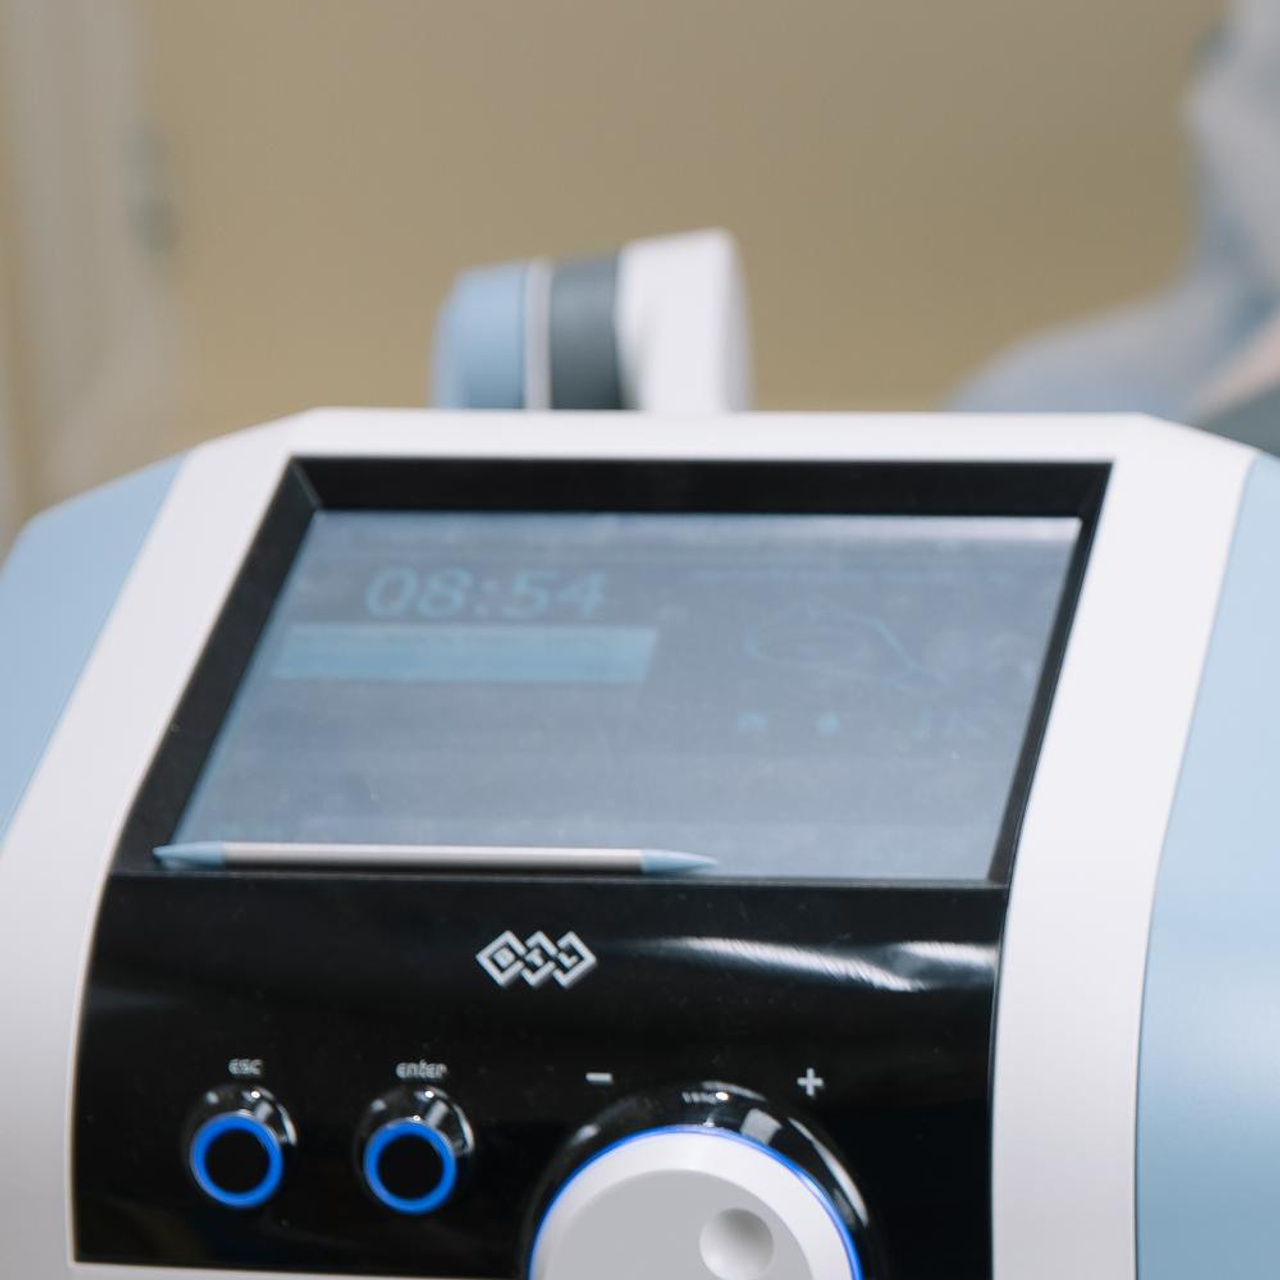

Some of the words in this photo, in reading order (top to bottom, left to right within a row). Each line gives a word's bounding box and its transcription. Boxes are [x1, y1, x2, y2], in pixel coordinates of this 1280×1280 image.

[364, 566, 607, 618] 08:54
[228, 1058, 263, 1076] esc
[396, 1059, 449, 1079] enter
